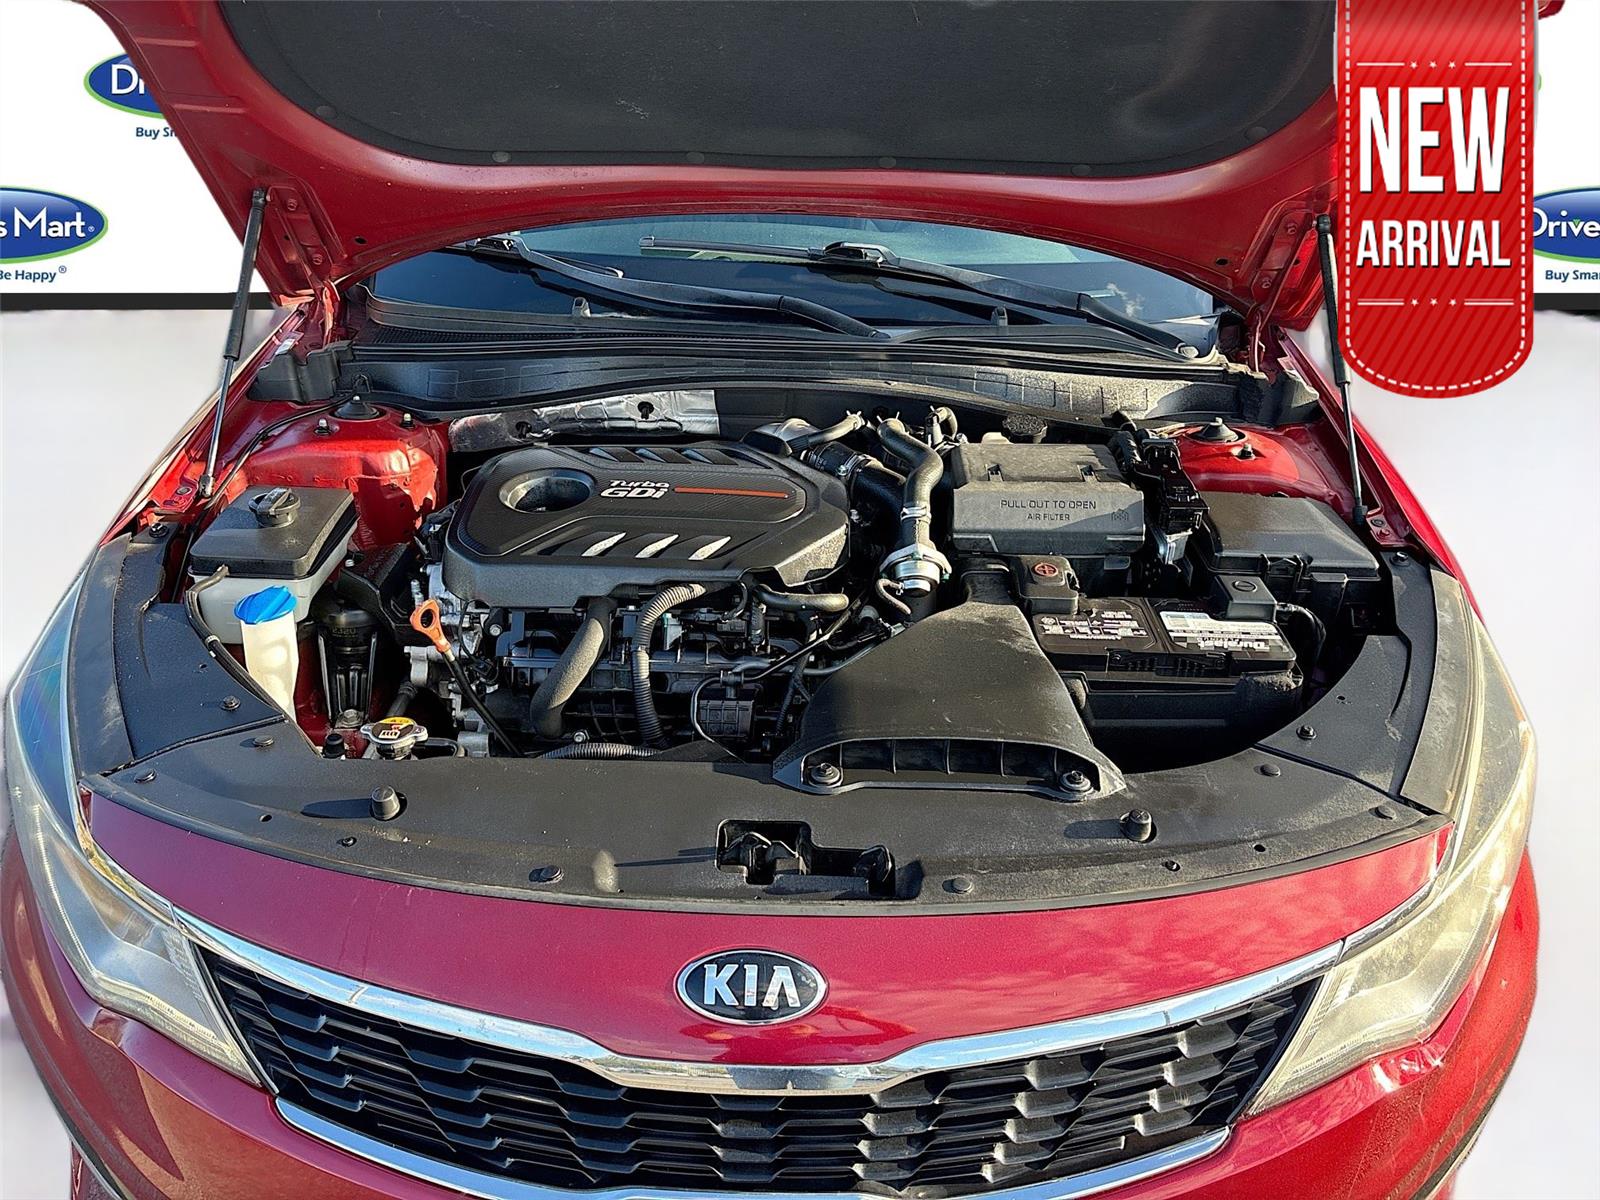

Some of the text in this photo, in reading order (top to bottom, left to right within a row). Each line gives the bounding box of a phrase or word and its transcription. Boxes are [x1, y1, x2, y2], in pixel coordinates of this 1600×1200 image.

[136, 127, 160, 140] Buy
[14, 206, 86, 237] Mart
[15, 270, 56, 283] Happy
[1545, 270, 1569, 283] Buy
[610, 480, 669, 488] Turbo
[1001, 500, 1096, 510] PULL OUT TO OPEN
[1027, 513, 1070, 521] AIR FILTER
[704, 964, 801, 1007] KIA
